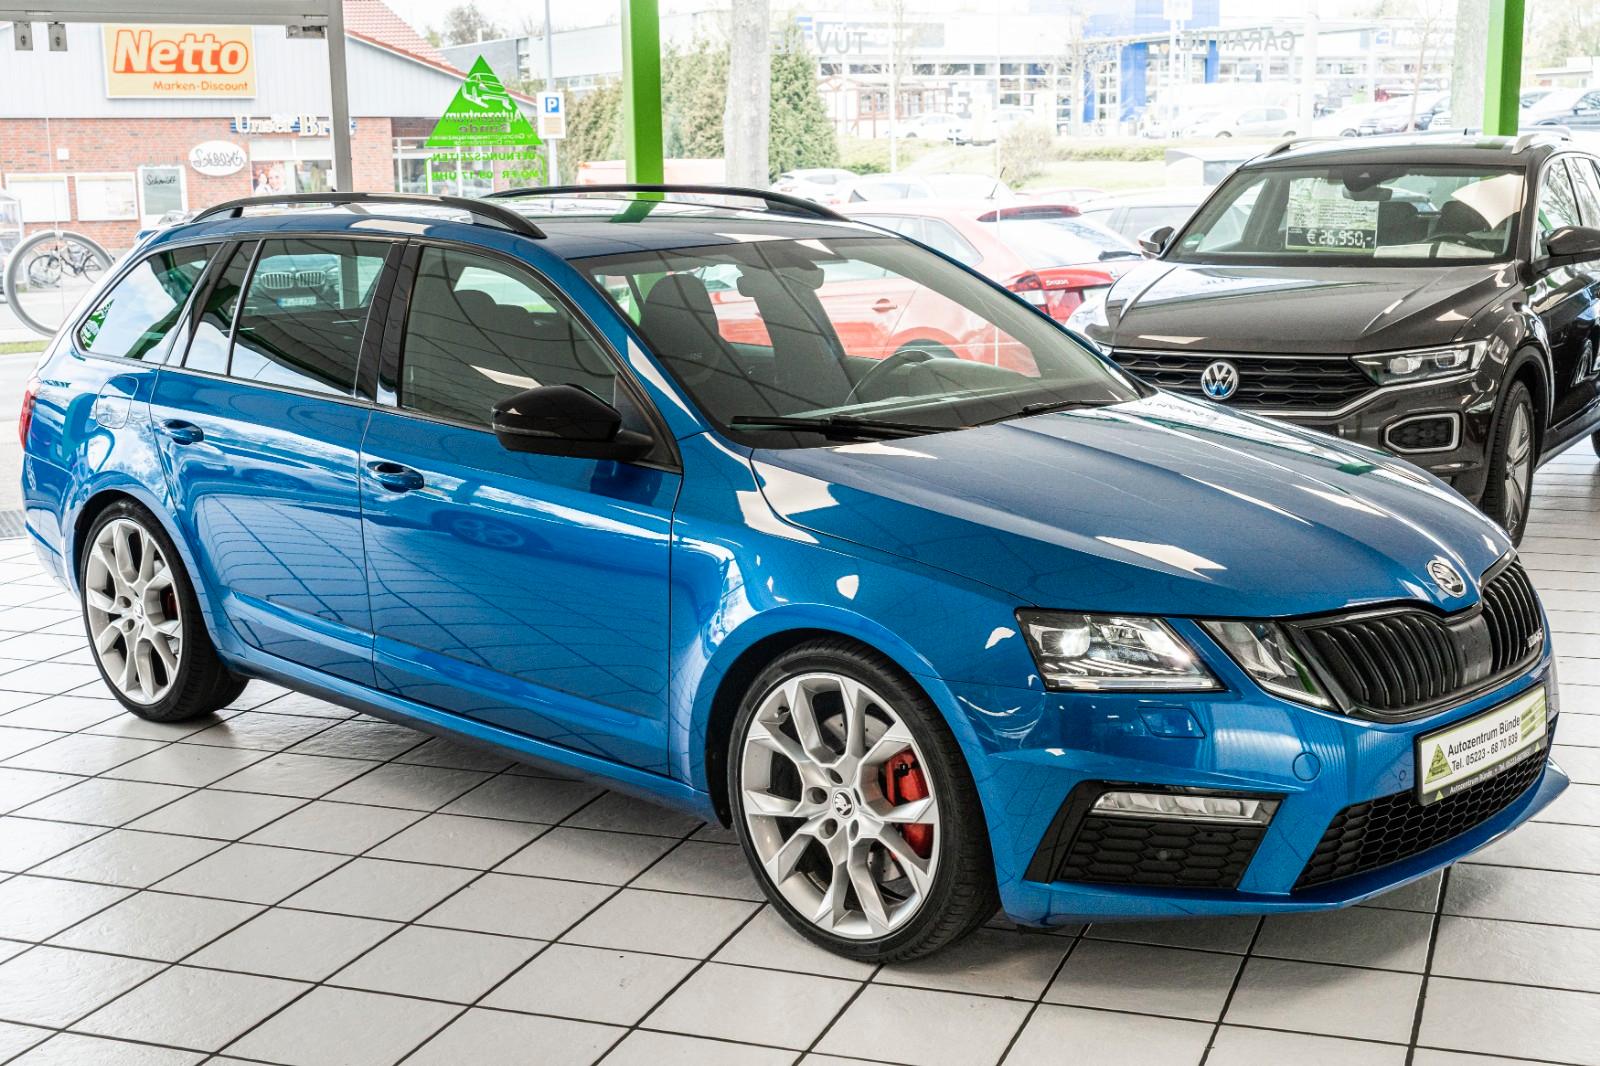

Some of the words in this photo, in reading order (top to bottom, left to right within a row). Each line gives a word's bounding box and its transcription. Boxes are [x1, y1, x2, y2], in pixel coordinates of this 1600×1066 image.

[113, 29, 248, 74] Netto
[547, 98, 559, 112] P
[1306, 228, 1317, 244] €
[1448, 727, 1498, 758] Autozentrum
[1499, 715, 1521, 735] Bünde
[1451, 759, 1464, 772] Tel.
[1465, 749, 1486, 766] 05223
[1490, 743, 1499, 755] 68
